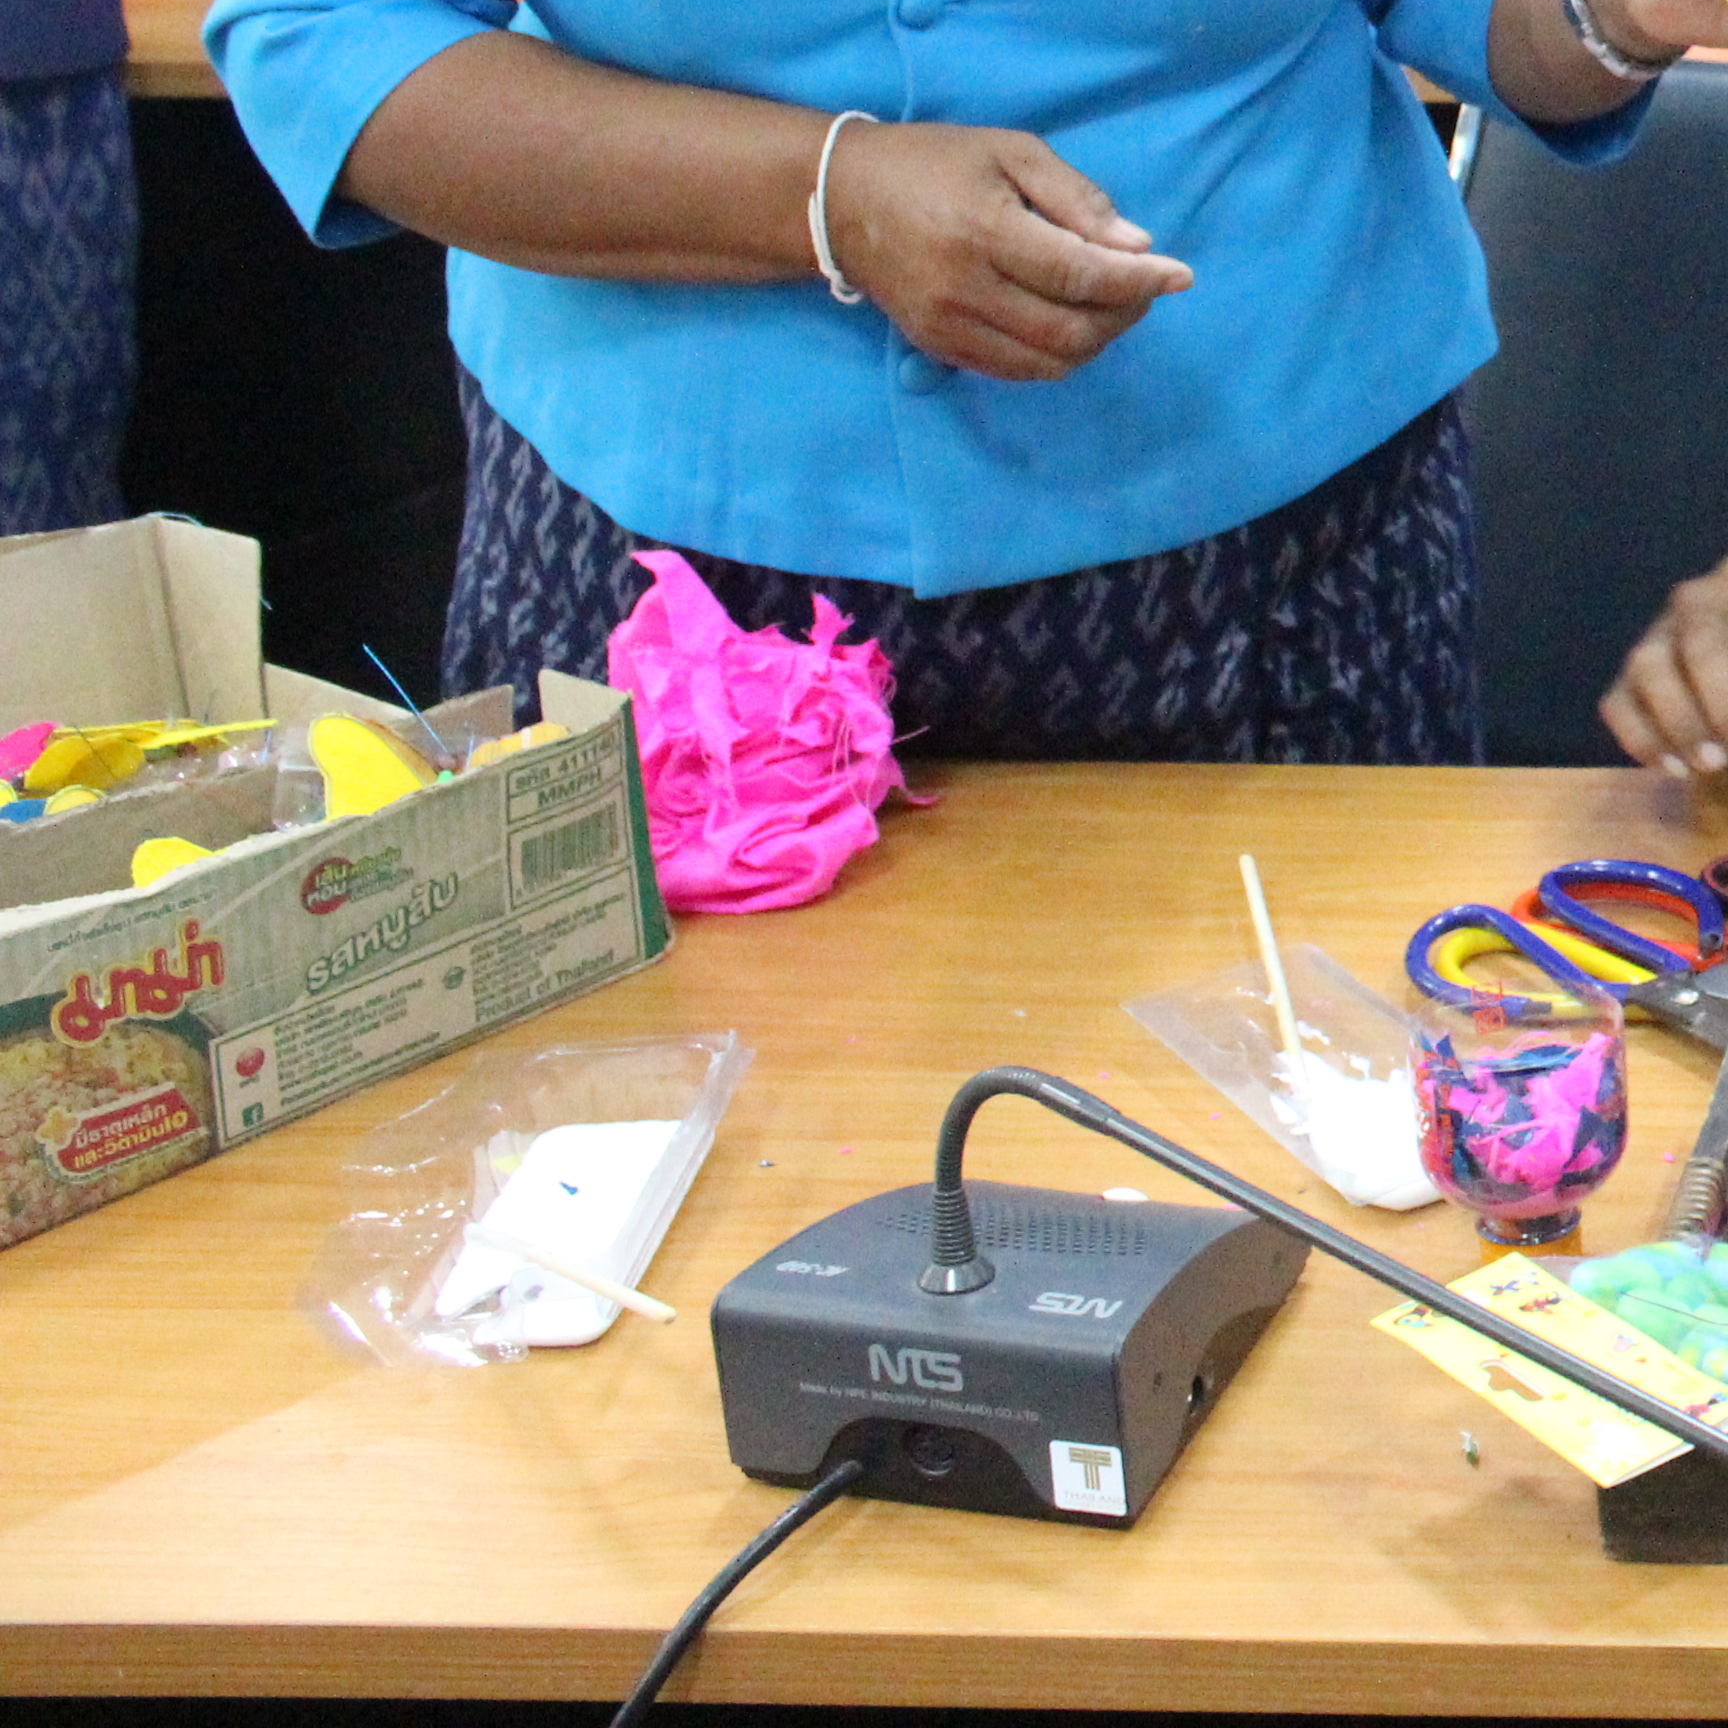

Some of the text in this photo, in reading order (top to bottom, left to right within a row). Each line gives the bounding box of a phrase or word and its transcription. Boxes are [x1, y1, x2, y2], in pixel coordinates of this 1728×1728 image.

[537, 767, 603, 807] MMPH
[56, 917, 227, 1044] มาม่า
[306, 871, 460, 995] รสหมูสับ
